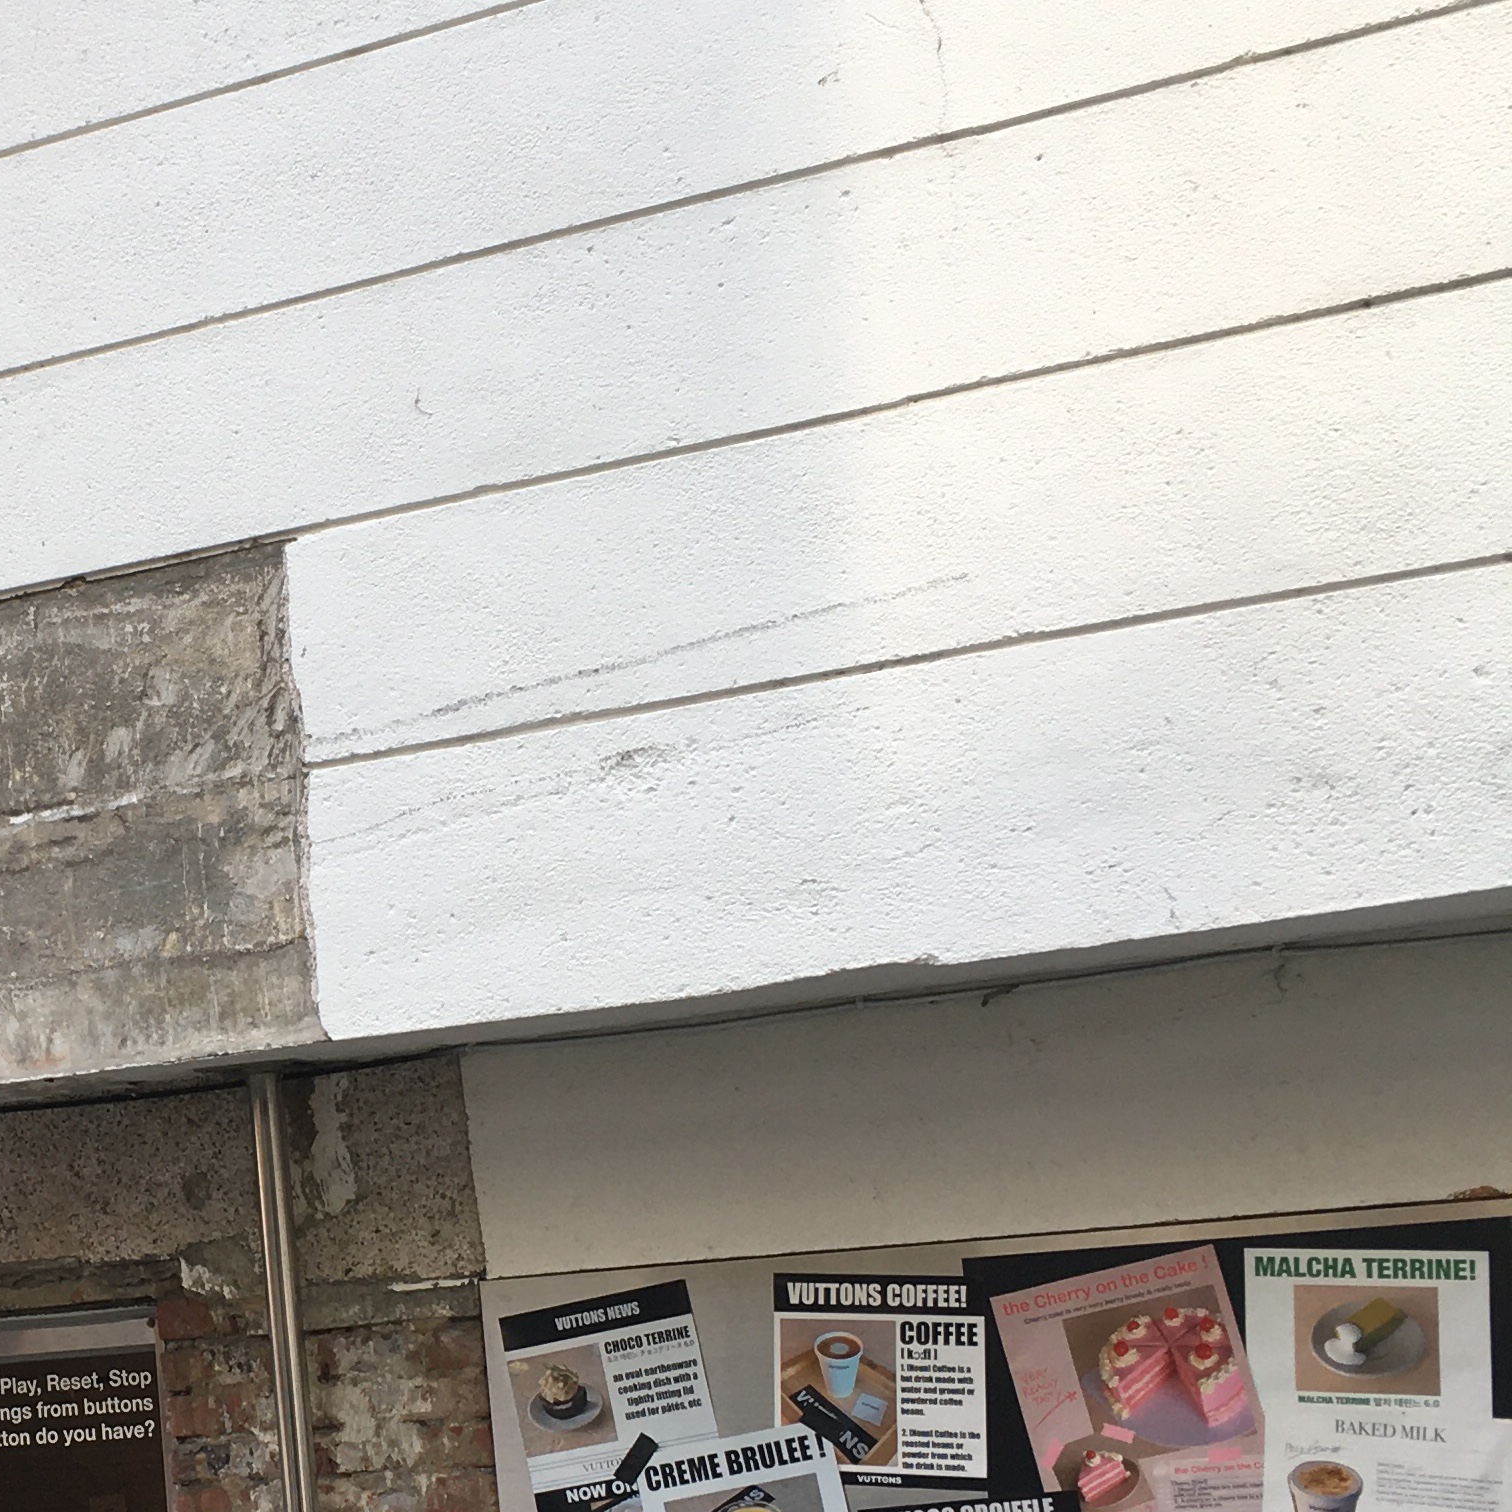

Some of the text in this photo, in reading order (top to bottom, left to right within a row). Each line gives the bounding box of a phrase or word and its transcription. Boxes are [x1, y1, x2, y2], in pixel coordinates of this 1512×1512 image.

[1254, 1256, 1476, 1281] MALCHA TERRINE!
[787, 1282, 967, 1308] VUTTONS COFFEE!
[1002, 1301, 1030, 1316] the
[1033, 1287, 1091, 1310] Cherry
[1096, 1281, 1118, 1294] on
[1121, 1271, 1149, 1289] the
[1152, 1260, 1198, 1280] Cake
[554, 1301, 640, 1331] VUTTONS NEWS
[604, 1335, 643, 1354] CHOCO
[644, 1325, 690, 1346] TERRINE
[900, 1321, 978, 1347] COFFEE
[0, 1369, 152, 1397] Play, Reset, Stop
[618, 1373, 691, 1395] cooking dish with
[36, 1400, 78, 1420] from
[83, 1397, 154, 1416] buttons
[625, 1398, 702, 1420] used etc
[1298, 1395, 1334, 1405] MALCHA
[1336, 1396, 1371, 1406] TERRINE
[36, 1427, 59, 1445] do
[64, 1428, 97, 1447] you
[101, 1420, 155, 1441] have?
[1335, 1419, 1447, 1443] BAKED MILK
[583, 1457, 624, 1472] VUTTO
[645, 1453, 723, 1491] CREME
[724, 1435, 814, 1476] BRULEE
[857, 1474, 902, 1484] VUTTONS
[566, 1483, 606, 1503] NOW
